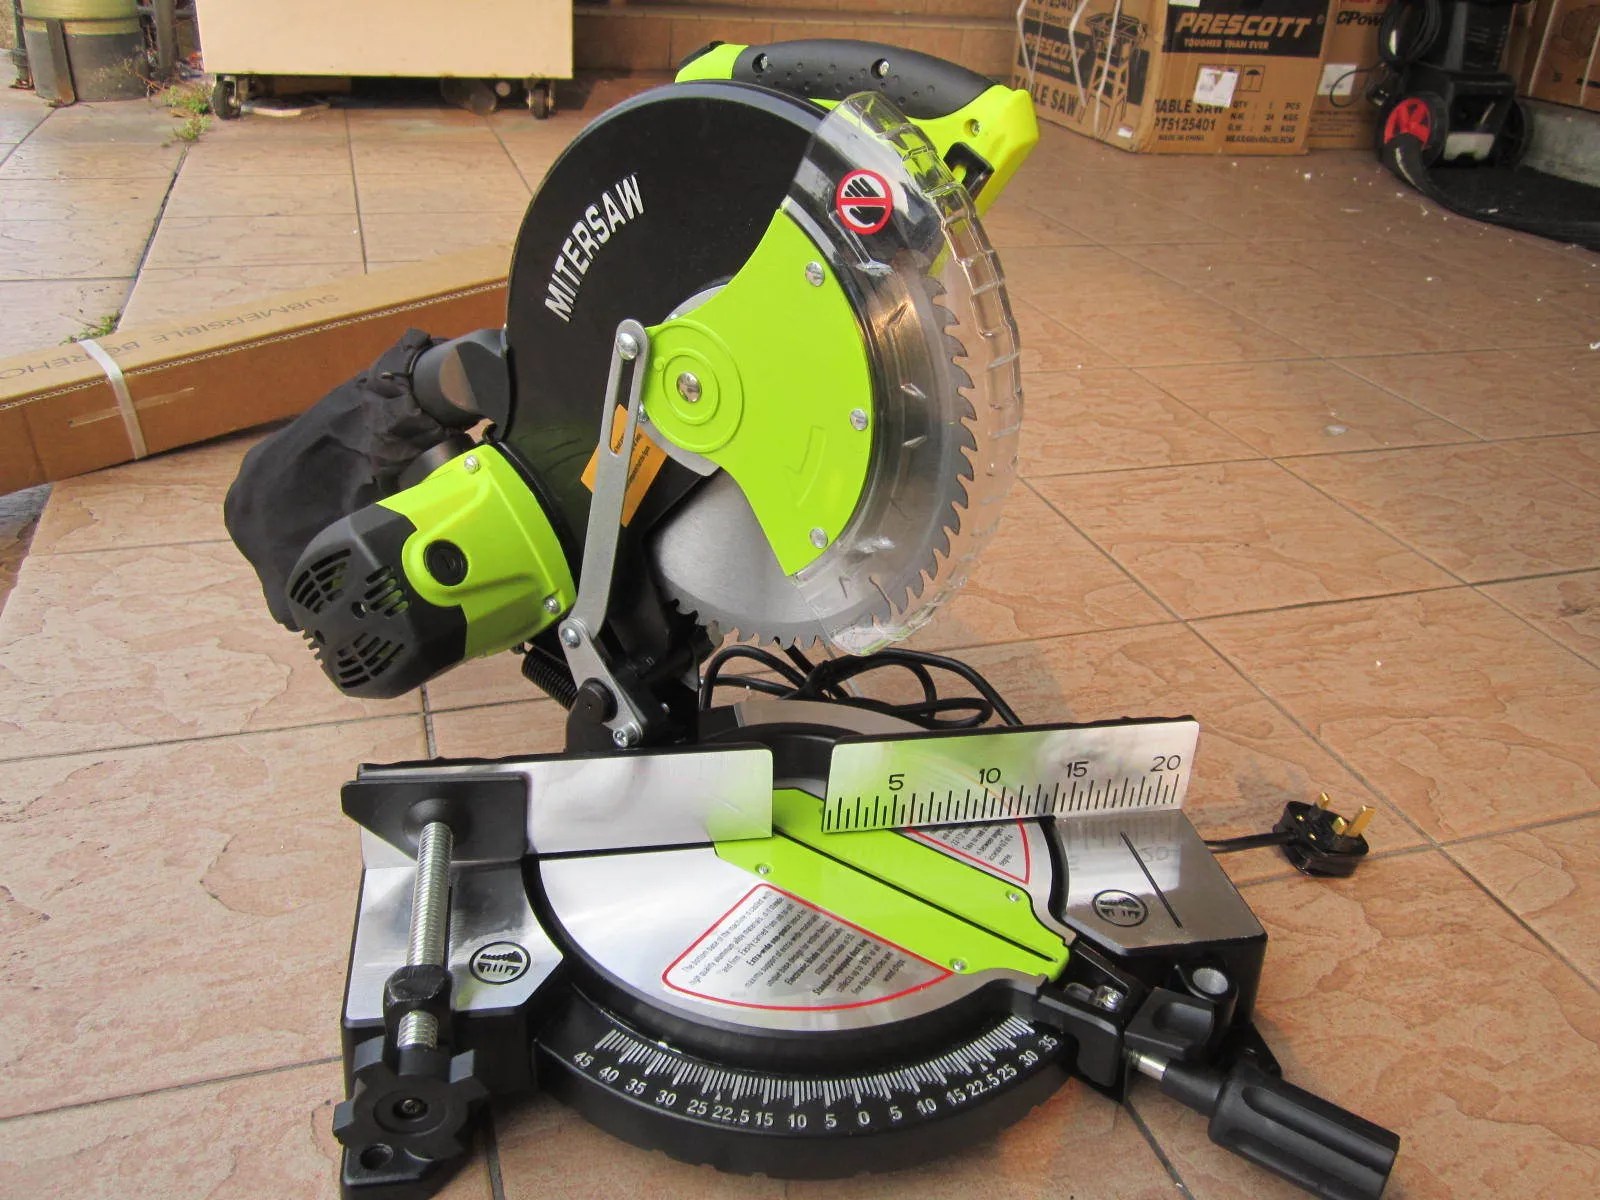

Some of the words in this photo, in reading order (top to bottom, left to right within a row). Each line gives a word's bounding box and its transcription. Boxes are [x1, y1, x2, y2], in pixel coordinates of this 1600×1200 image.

[1175, 12, 1312, 38] PRESCOTT
[1050, 88, 1080, 116] SAW
[1154, 98, 1193, 113] TABLE
[544, 173, 645, 322] MITERSAW
[152, 294, 339, 344] SUBMERSIBLE
[888, 774, 905, 791] 5
[979, 767, 1001, 784] 10
[1066, 761, 1089, 778] 15
[1150, 754, 1181, 772] 20
[573, 1051, 594, 1068] 45
[599, 1066, 619, 1083] 40
[625, 1078, 648, 1095] 35
[655, 1090, 677, 1106] 30
[686, 1099, 708, 1116] 25
[712, 1105, 750, 1124] 22.5
[754, 1111, 774, 1127] 15
[787, 1114, 808, 1129] 10
[825, 1113, 837, 1129] 5
[858, 1110, 871, 1126] 0
[889, 1105, 903, 1121] 5
[917, 1098, 937, 1116] 10
[946, 1088, 967, 1106] 15
[966, 1073, 1000, 1097] 22.5
[997, 1064, 1018, 1081] 25
[1018, 1050, 1039, 1067] 30
[1038, 1034, 1058, 1051] 35
